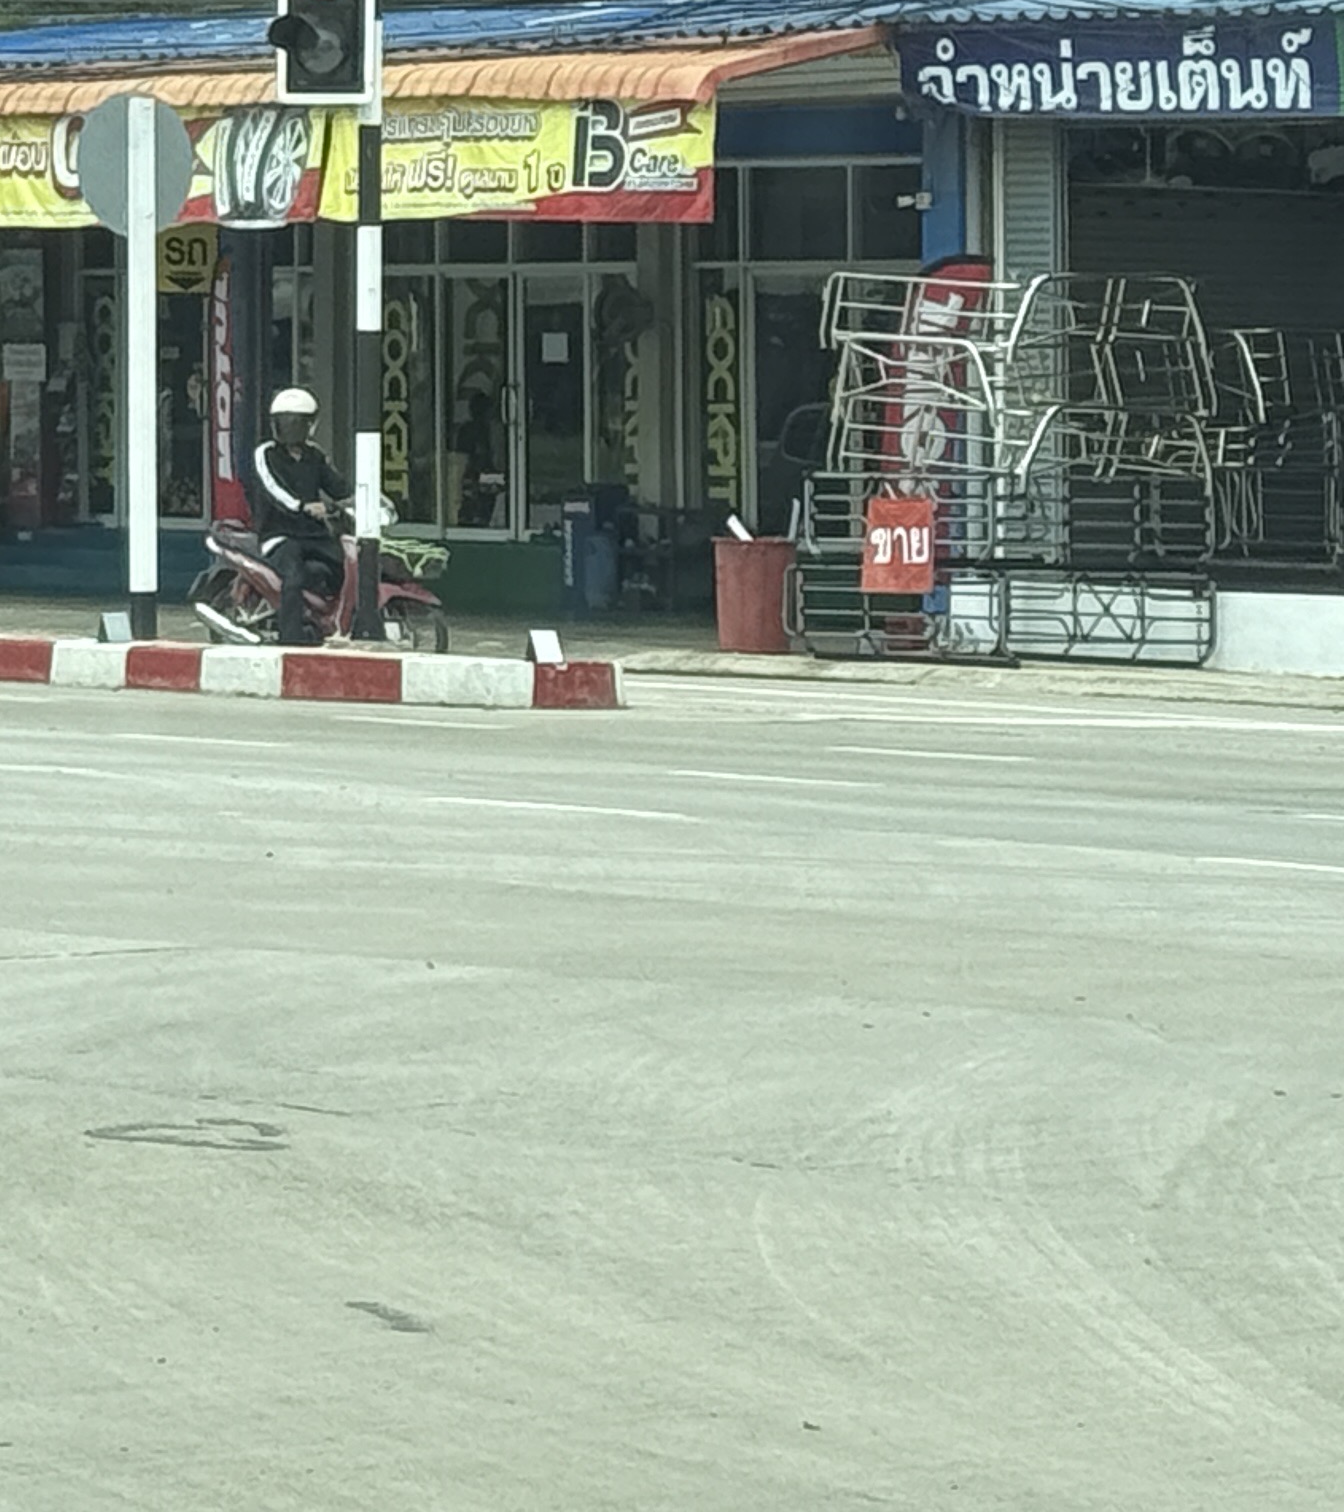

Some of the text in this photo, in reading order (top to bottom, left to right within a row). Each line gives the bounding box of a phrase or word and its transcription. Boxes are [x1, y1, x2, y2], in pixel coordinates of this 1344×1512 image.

[918, 25, 1312, 113] จำหน่ายเต็นท์
[629, 147, 680, 174] Care
[870, 524, 930, 565] ขาย
